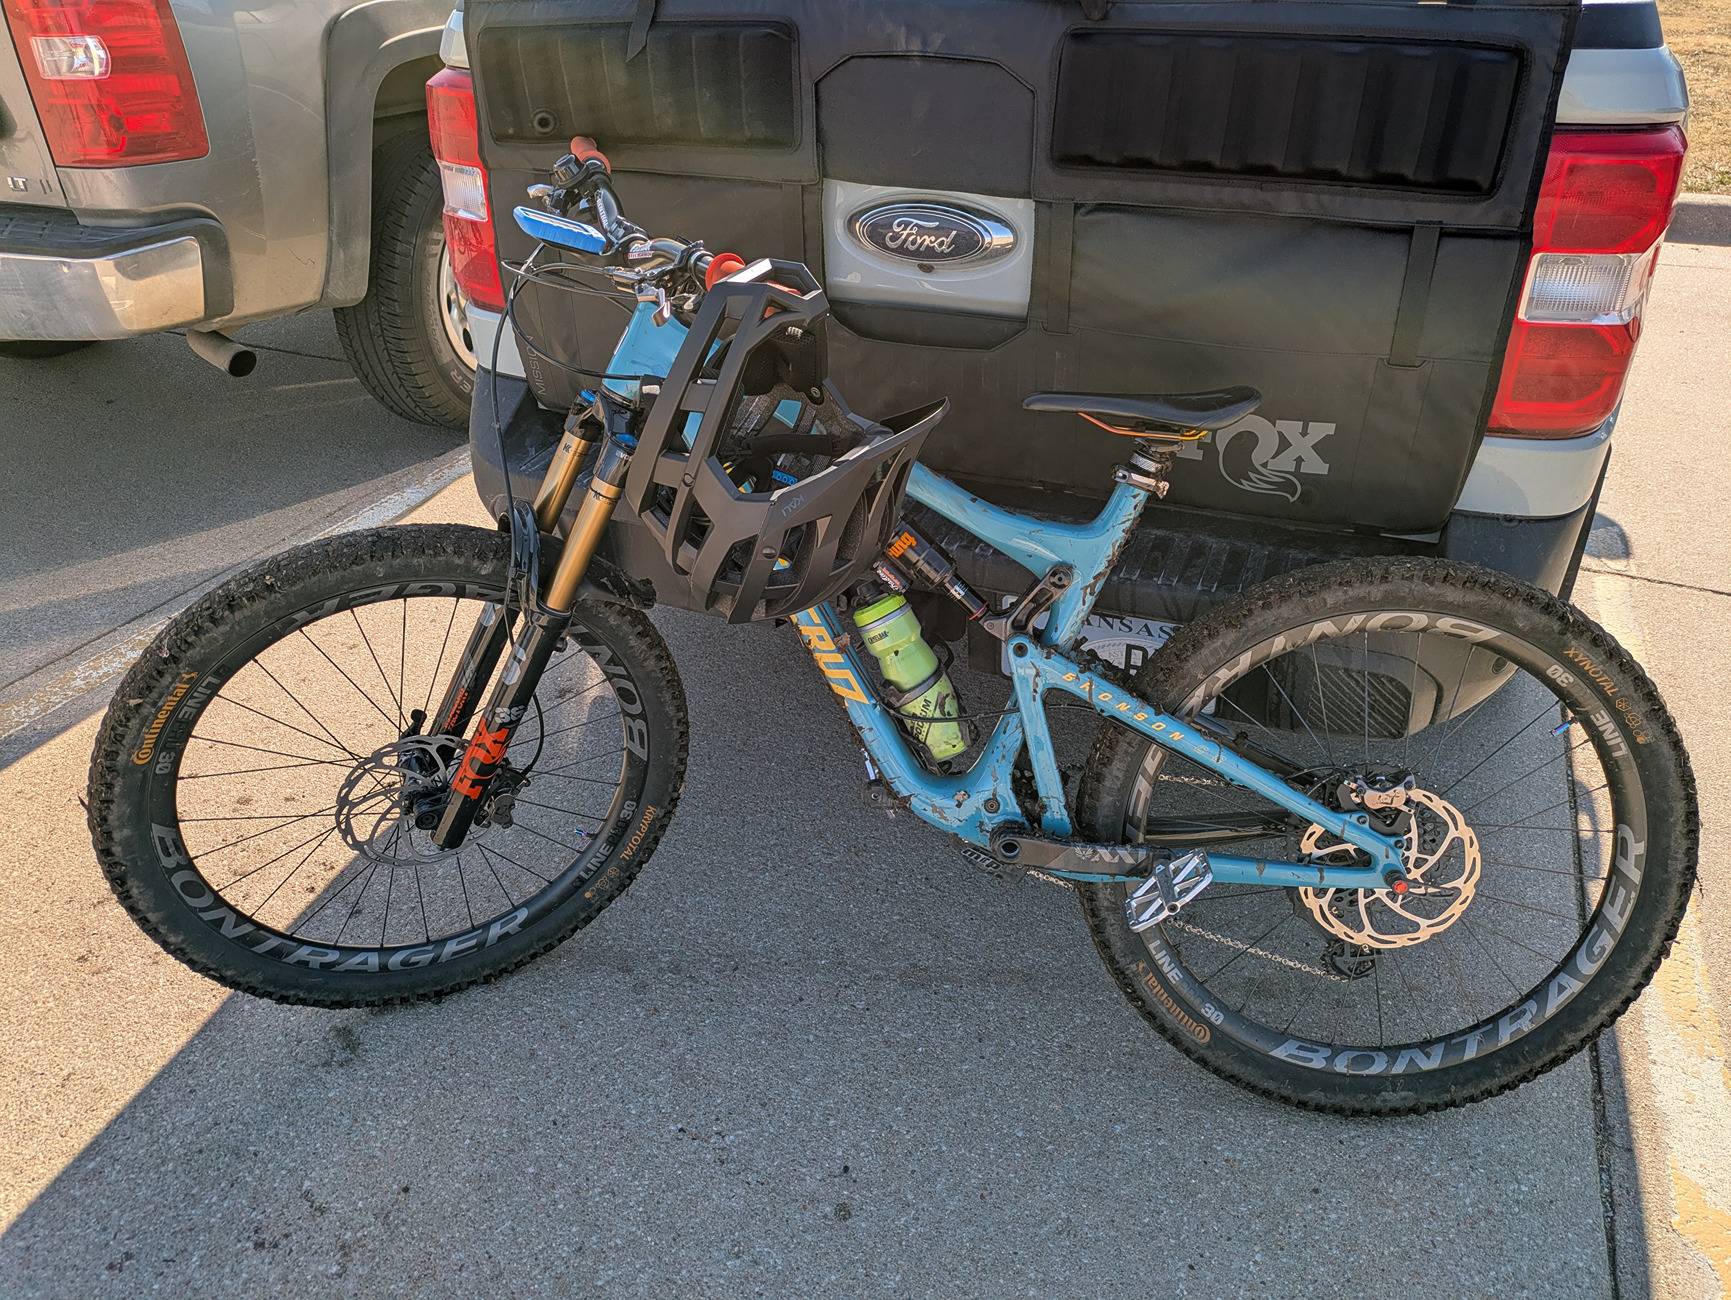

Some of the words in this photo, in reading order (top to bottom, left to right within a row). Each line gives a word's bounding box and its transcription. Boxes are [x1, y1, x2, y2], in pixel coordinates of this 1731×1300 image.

[7, 176, 28, 192] LT
[885, 217, 957, 253] Ford
[1085, 615, 1174, 640] ANSAS
[179, 675, 221, 720] LINE
[1546, 664, 1575, 688] 30
[1563, 646, 1619, 697] XYNOTAL
[132, 683, 192, 766] Continental
[913, 697, 932, 742] PODUM
[1062, 672, 1184, 741] BRONSON
[1590, 709, 1628, 758] LINE
[155, 751, 176, 775] 30
[452, 717, 511, 800] FOX
[580, 843, 614, 880] LINE
[620, 800, 637, 821] 30
[619, 804, 657, 861] KRYPTOTAL
[151, 823, 528, 973] BONTRAGER
[1268, 823, 1645, 1075] BONTRAGER
[1145, 971, 1211, 1045] Continental
[1148, 940, 1184, 985] LINE
[1200, 1002, 1225, 1026] 30
